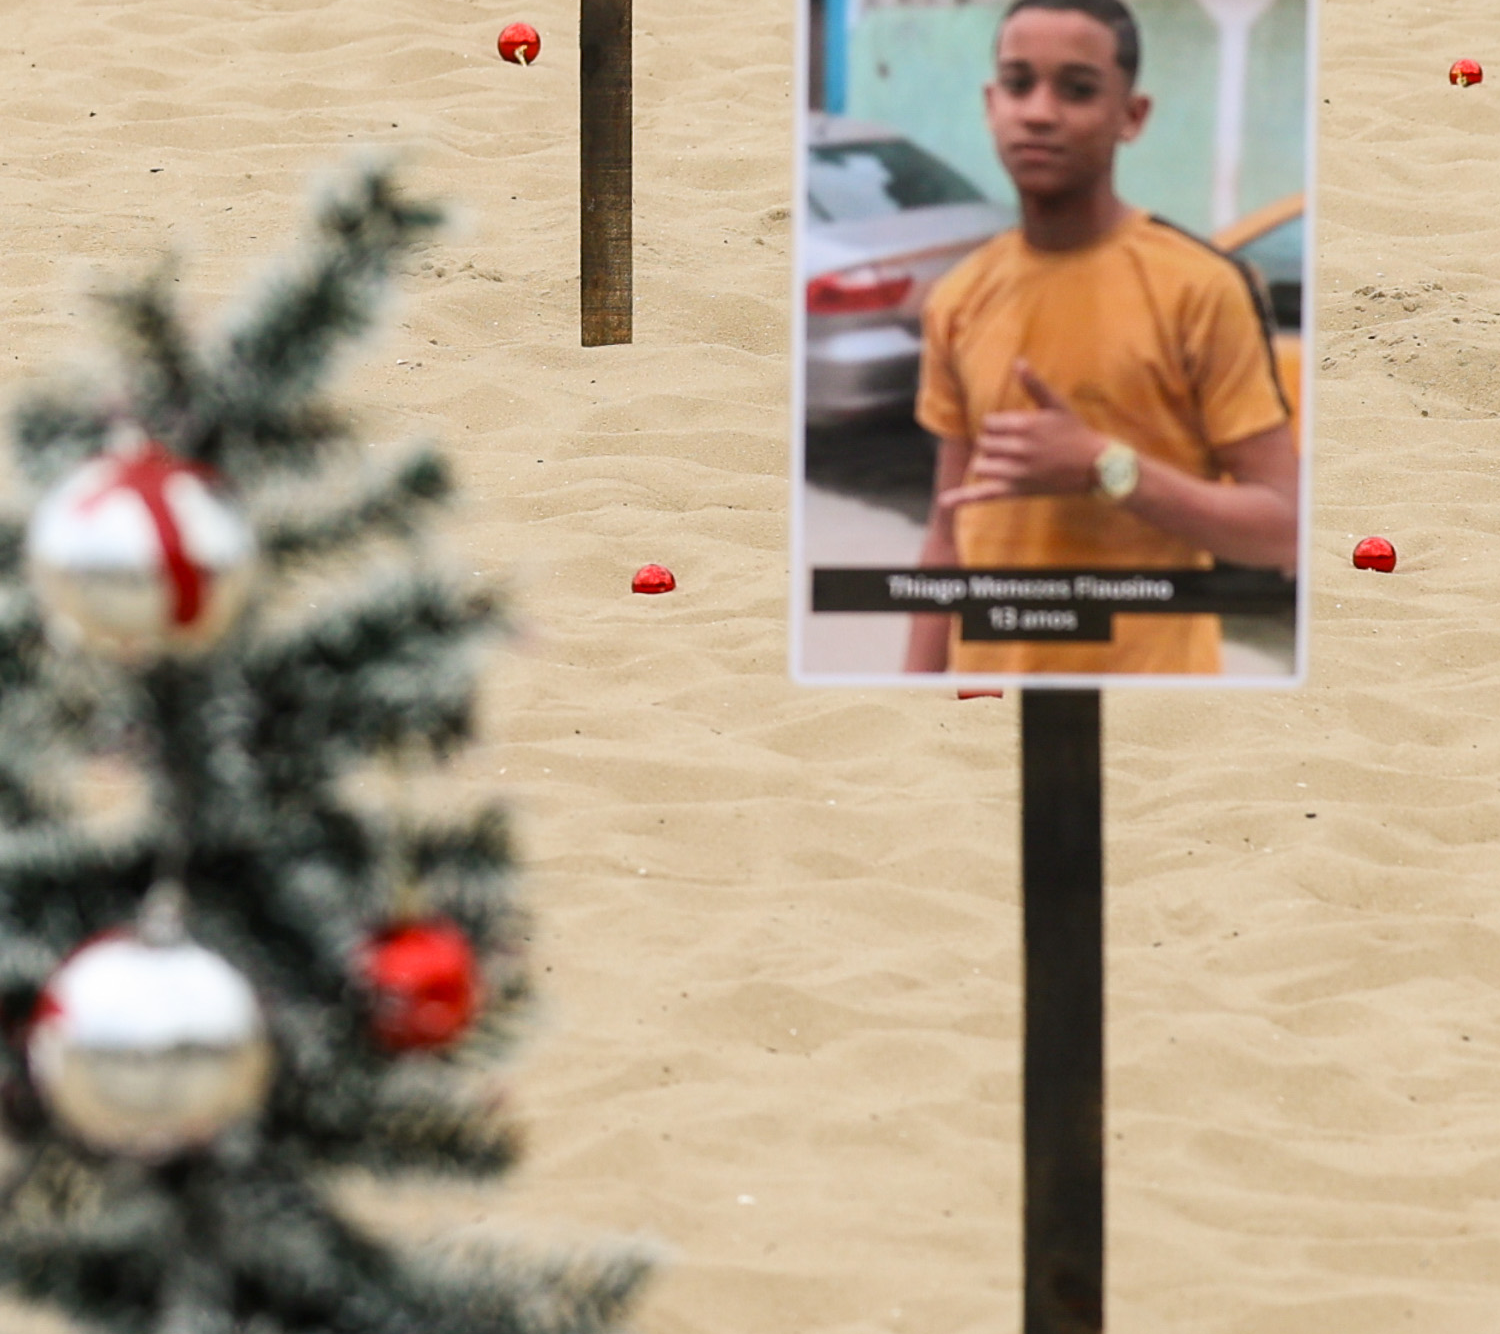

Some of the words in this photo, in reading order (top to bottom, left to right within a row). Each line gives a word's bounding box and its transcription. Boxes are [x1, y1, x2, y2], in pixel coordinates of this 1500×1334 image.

[886, 574, 967, 605] Thiago
[968, 576, 1072, 600] Menezes
[1019, 610, 1079, 631] anos
